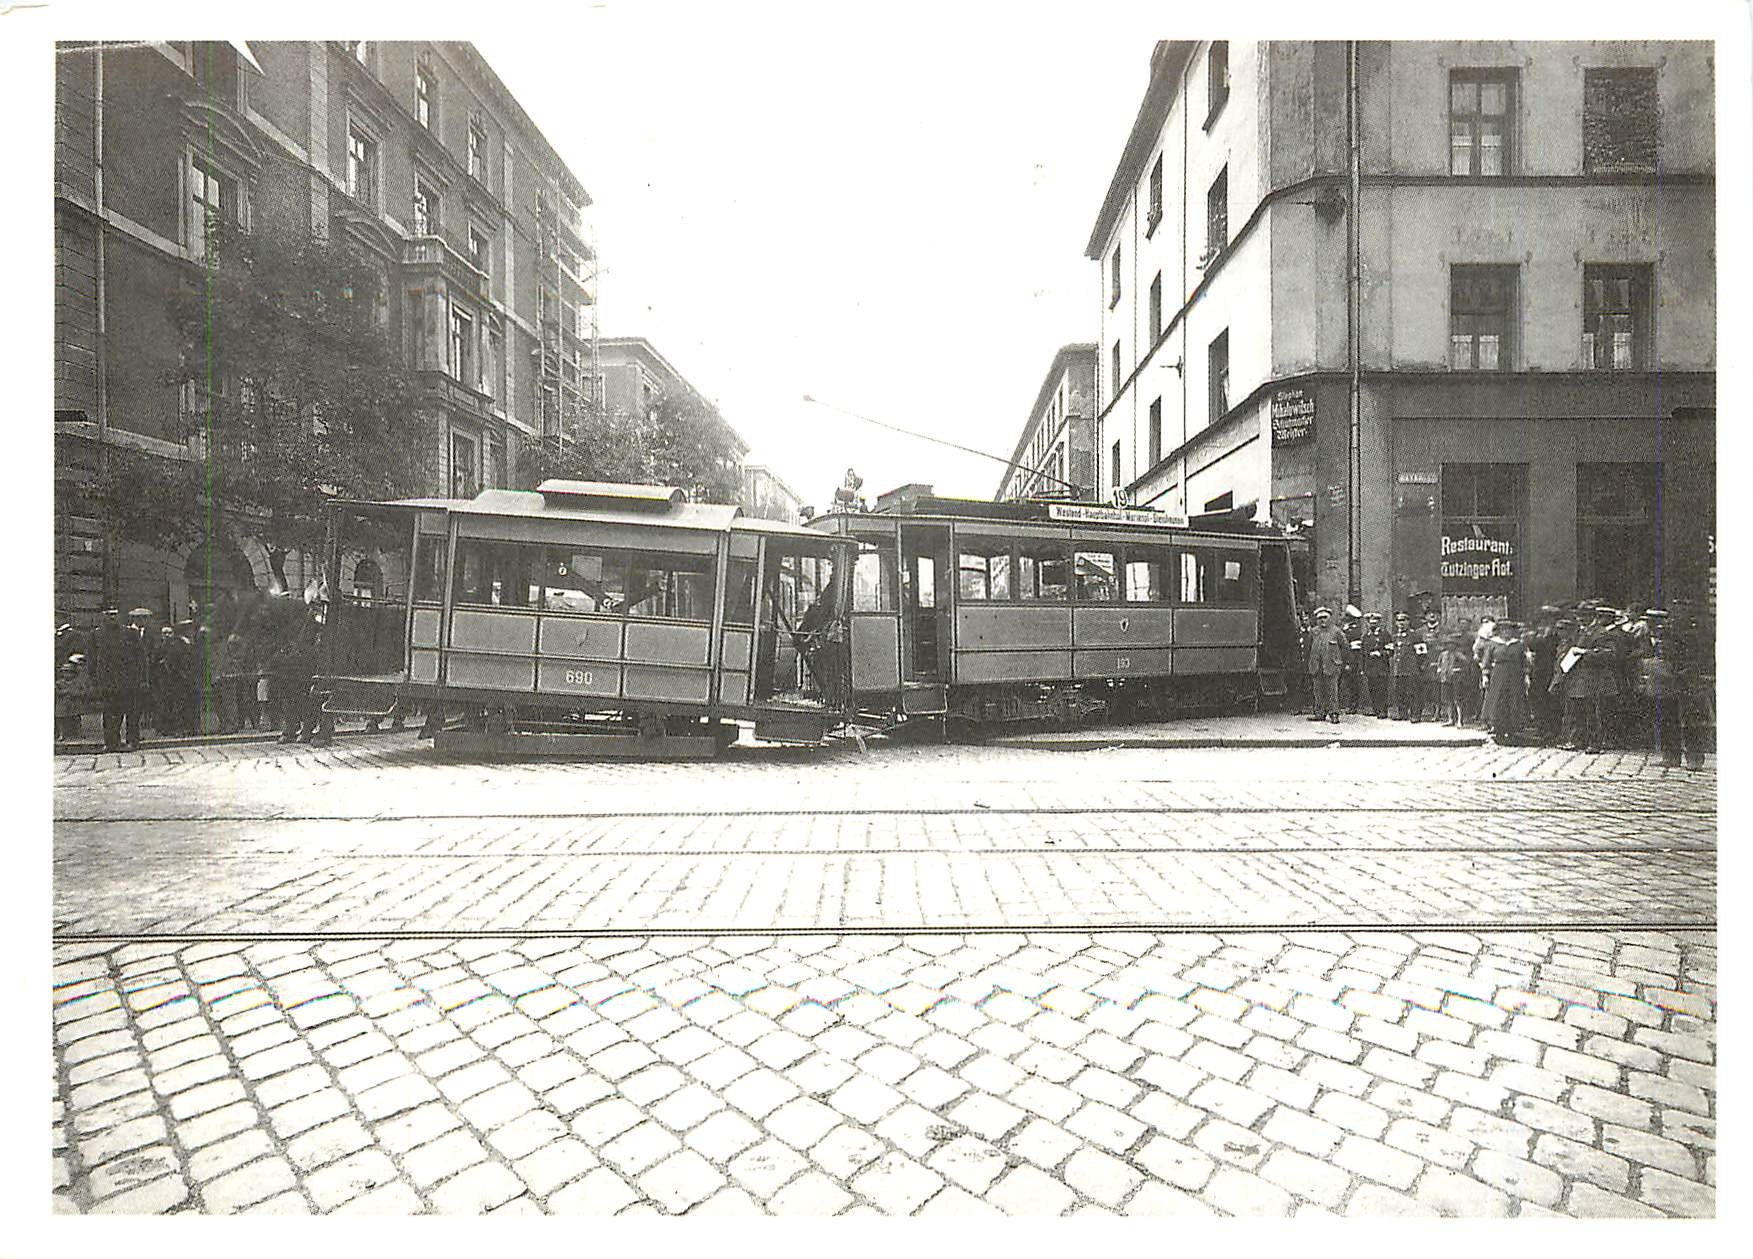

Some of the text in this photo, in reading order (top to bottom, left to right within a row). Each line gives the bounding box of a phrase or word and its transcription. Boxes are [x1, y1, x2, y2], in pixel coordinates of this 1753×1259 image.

[1113, 490, 1127, 506] 19
[1440, 561, 1490, 580] Tutzinger
[565, 670, 593, 685] 690
